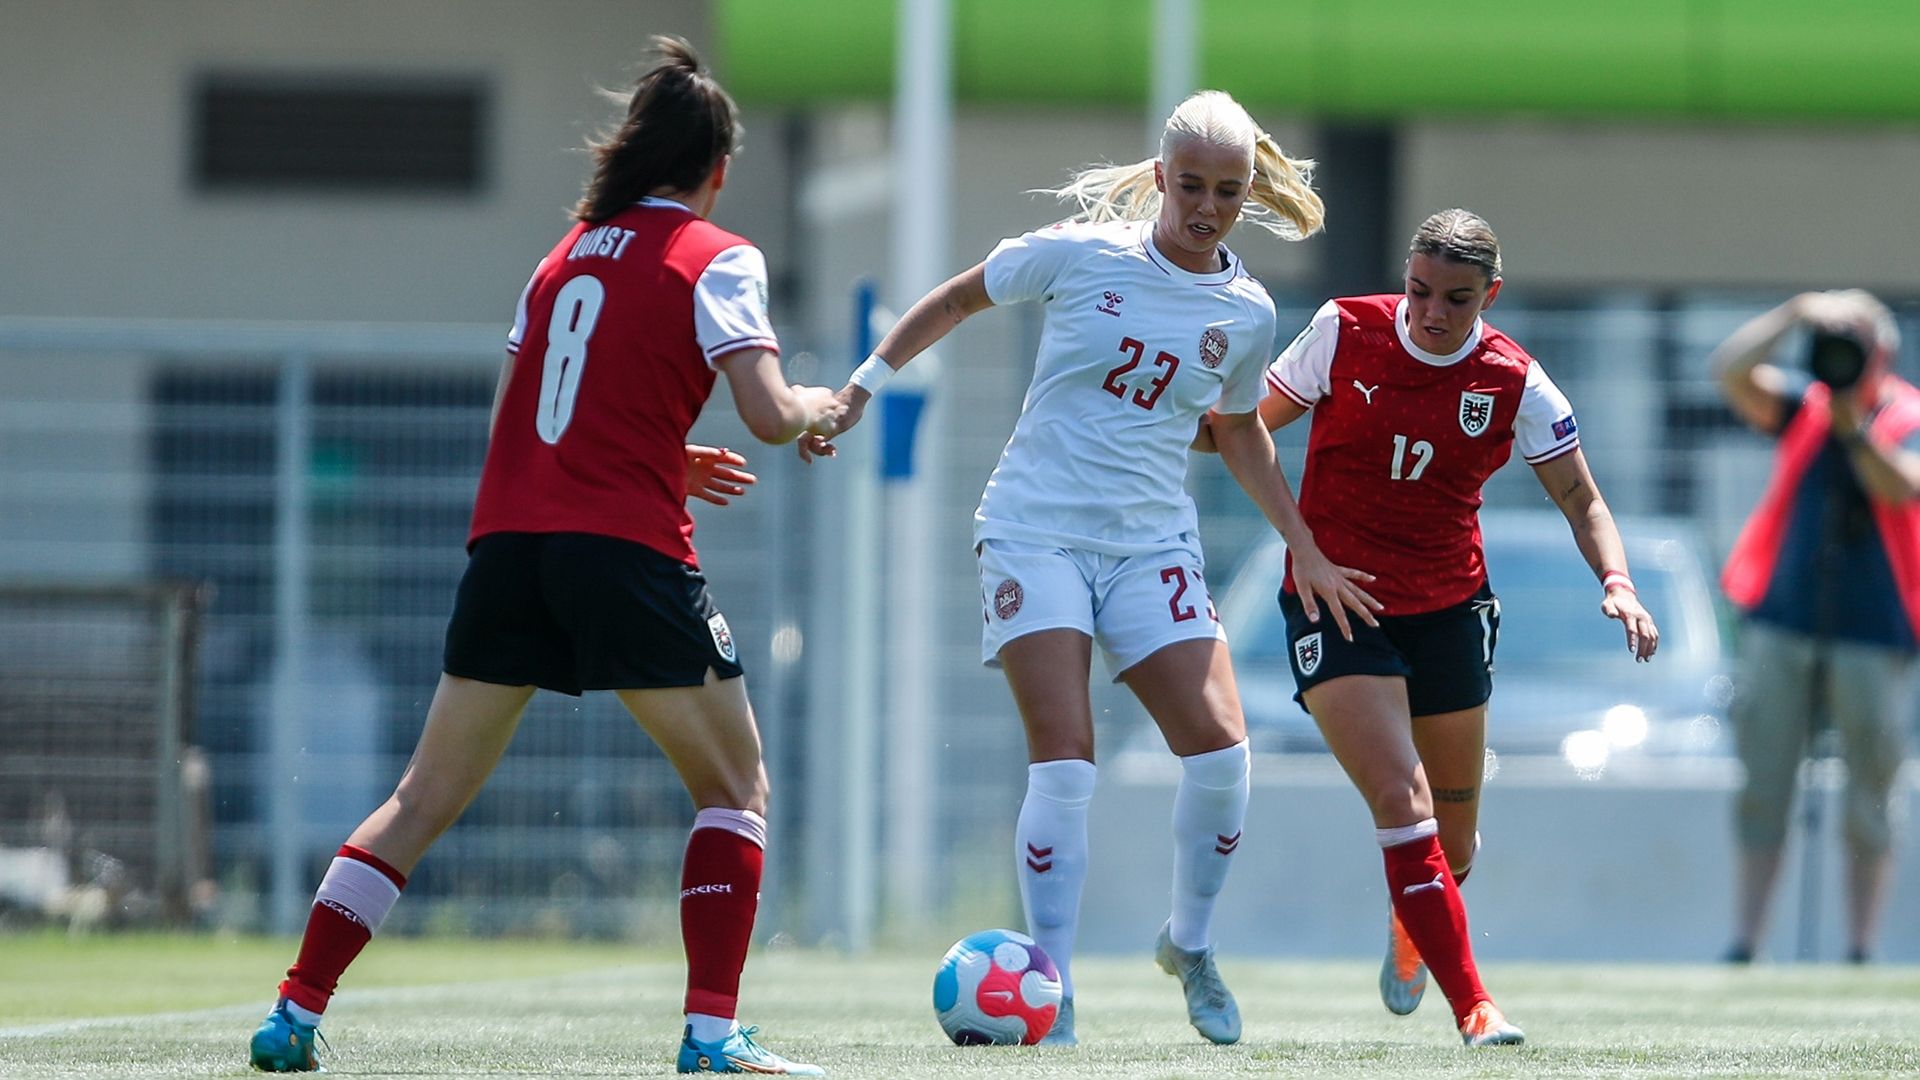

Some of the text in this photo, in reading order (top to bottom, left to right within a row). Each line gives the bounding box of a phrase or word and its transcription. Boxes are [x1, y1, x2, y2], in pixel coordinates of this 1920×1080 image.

[566, 225, 637, 261] DUNST
[535, 274, 606, 446] 8
[1102, 336, 1180, 410] 23
[1205, 338, 1224, 358] DBU
